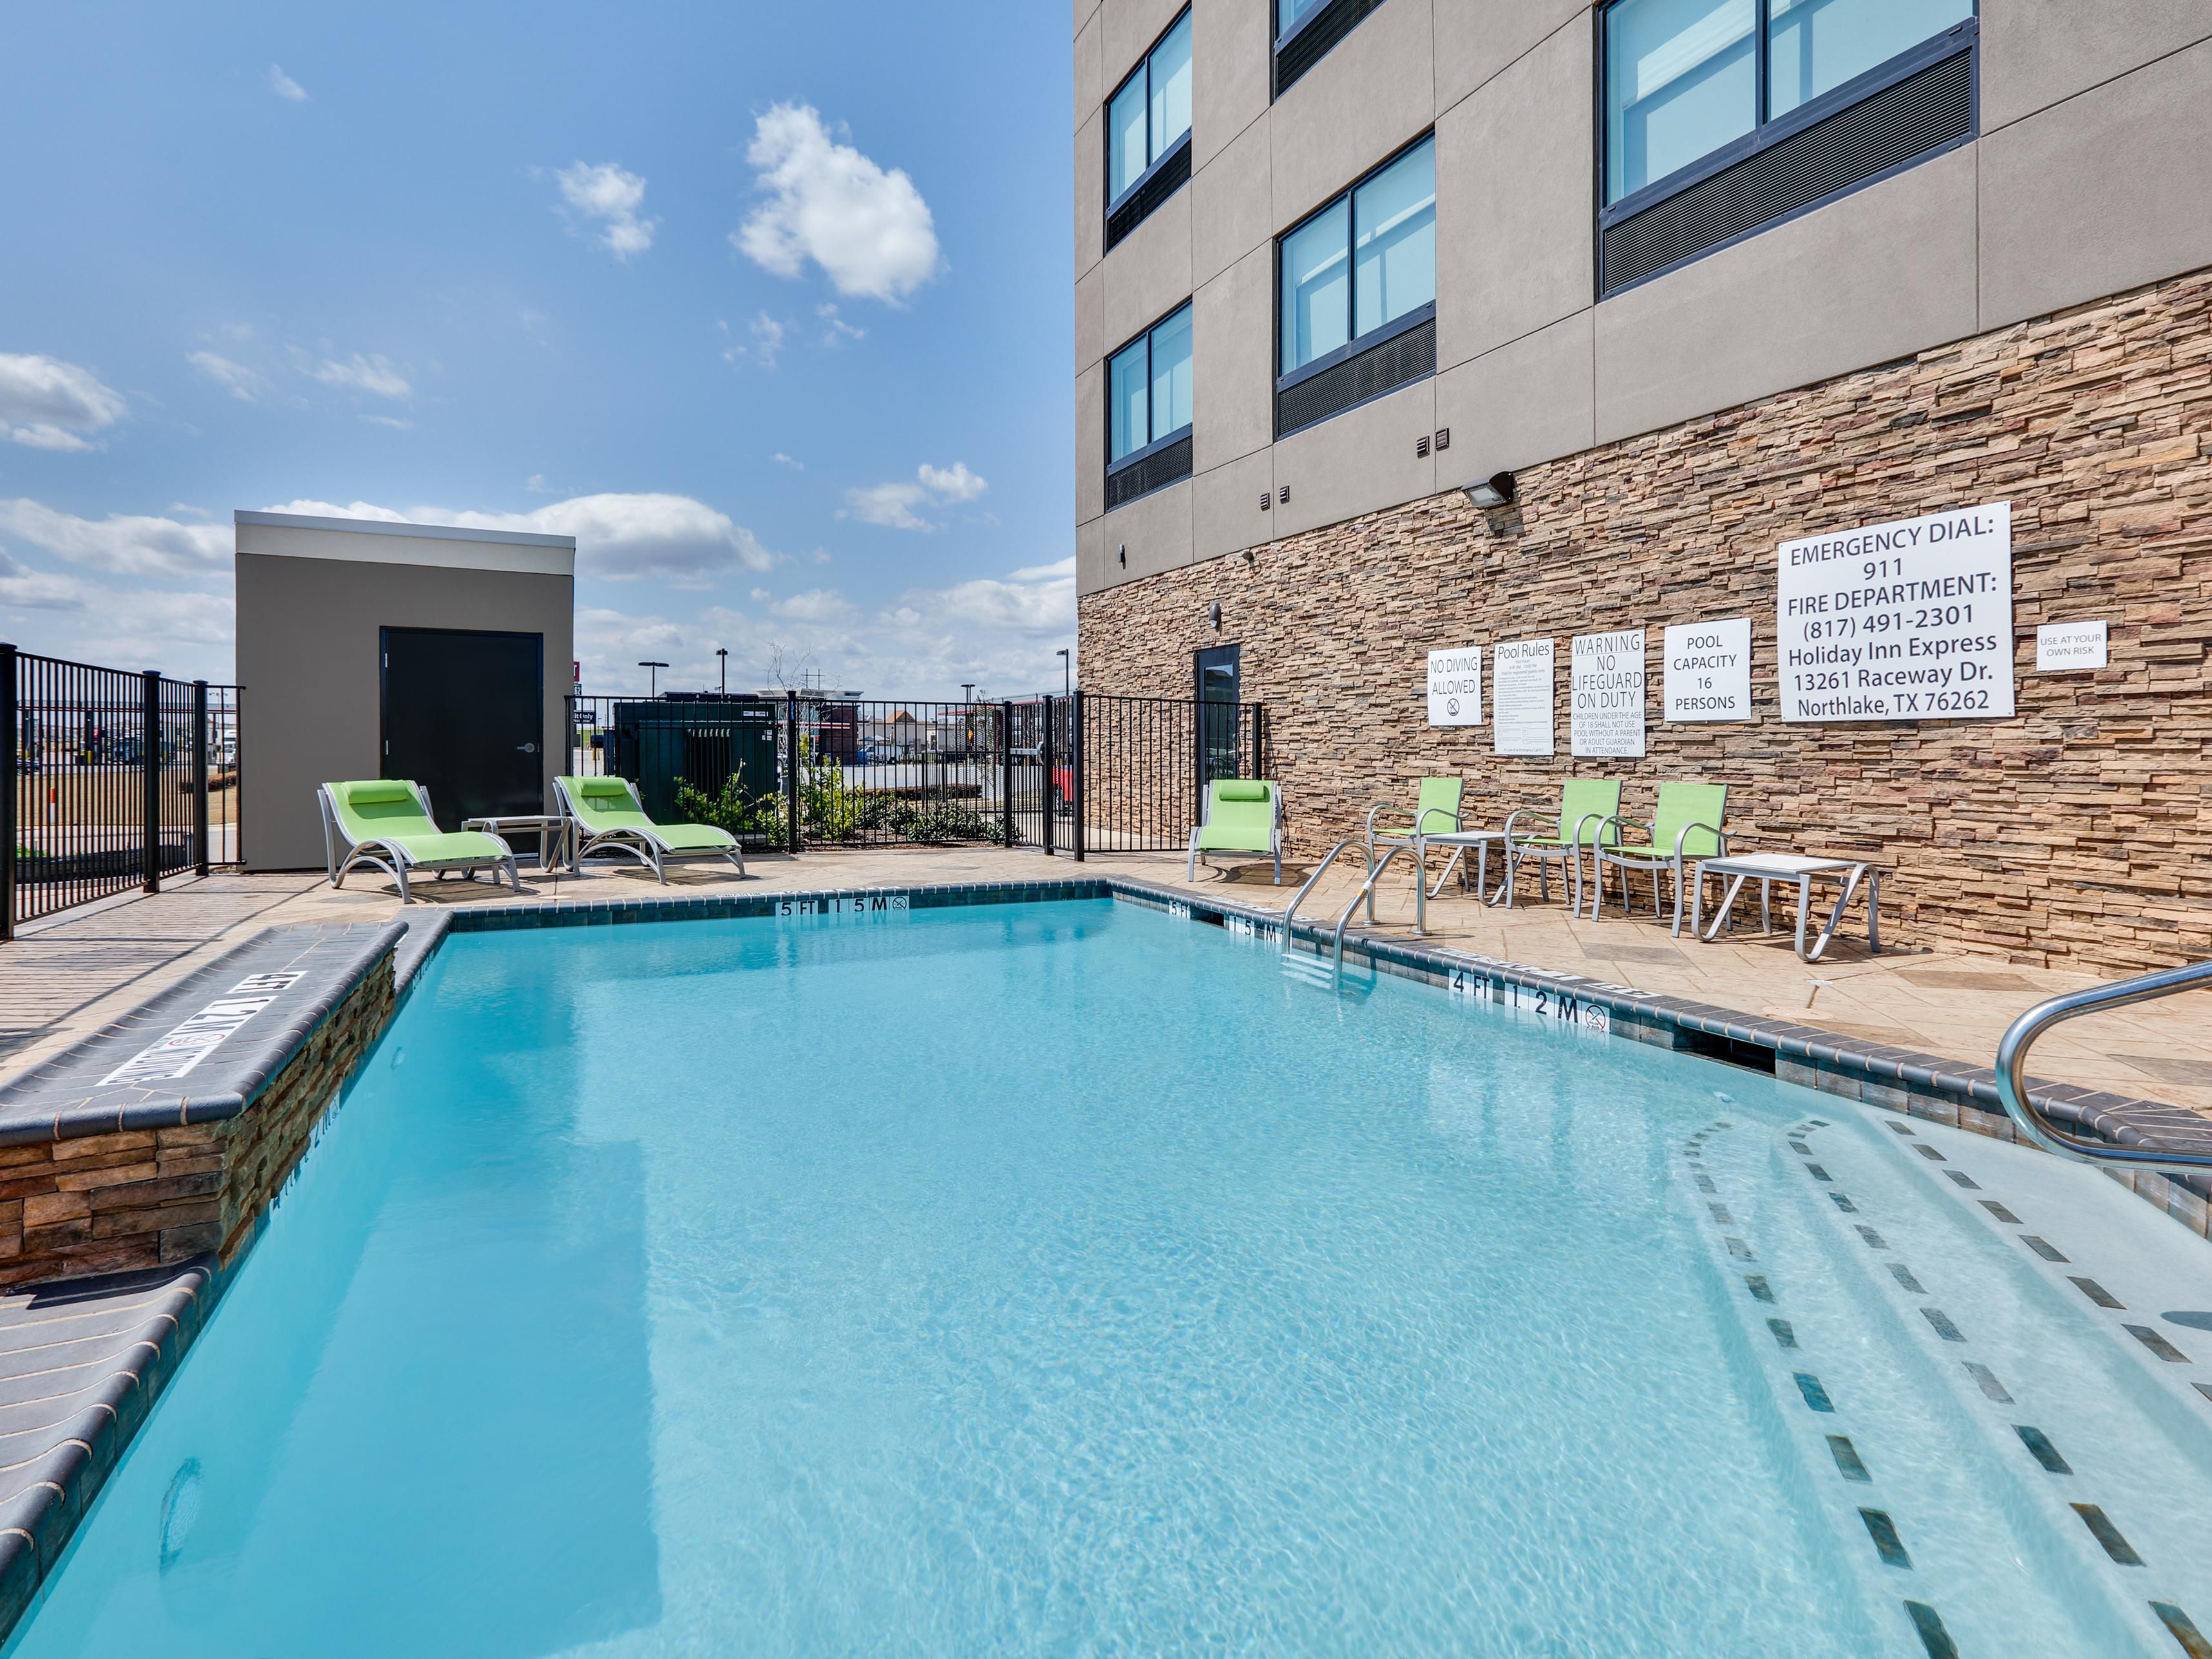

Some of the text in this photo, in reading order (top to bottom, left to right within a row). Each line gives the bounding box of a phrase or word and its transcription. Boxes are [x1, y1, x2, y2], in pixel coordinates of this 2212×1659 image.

[1791, 516, 1994, 565] EMERGENCY DIAL:
[1864, 558, 1902, 580] 911
[1789, 572, 1996, 616] FIRE DEPARTMENT:
[1804, 605, 1972, 642] (817) 491-2301
[1575, 634, 1640, 654] WARNING
[1687, 635, 1723, 649] POOL
[2074, 634, 2101, 643] YOUR
[1498, 642, 1550, 659] Pool Rules
[1789, 634, 1996, 667] Holiday Inn Express
[2047, 647, 2094, 657] OWN RISK
[1431, 656, 1477, 674] NO DIVING
[1597, 655, 1615, 671] NO
[1674, 654, 1737, 670] CAPACITY
[1573, 672, 1642, 691] LIFEGUARD
[1697, 677, 1712, 689] 16
[1794, 661, 1993, 691] 13261 Raceway Dr.
[1432, 679, 1475, 695] ALLOWED
[1578, 691, 1636, 708] ON DUTY
[1676, 696, 1735, 710] PERSONS
[1798, 690, 1989, 716] Northlake, TX 76262
[780, 900, 815, 916] 5 FT
[1171, 902, 1178, 916] 5
[1180, 904, 1189, 919] FT
[1266, 924, 1277, 943] M
[1453, 972, 1490, 999] 4 FT
[1557, 996, 1578, 1023] M
